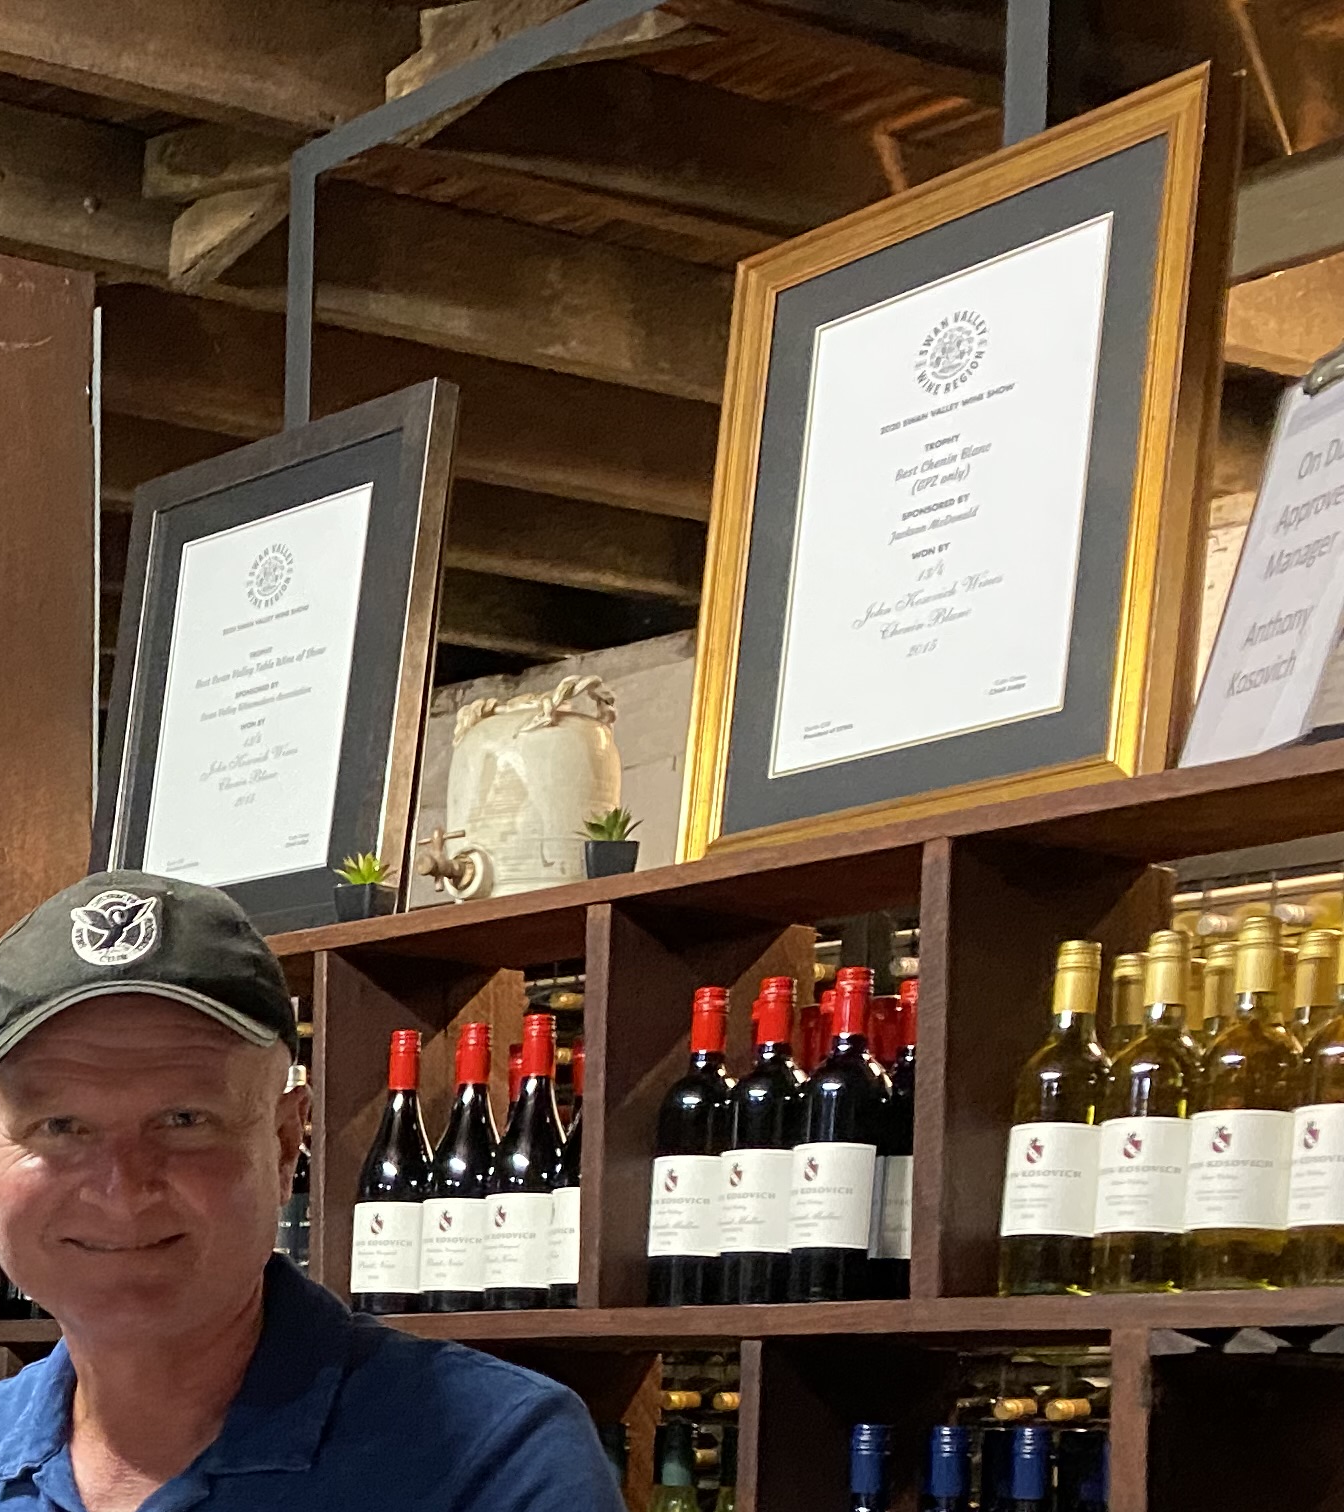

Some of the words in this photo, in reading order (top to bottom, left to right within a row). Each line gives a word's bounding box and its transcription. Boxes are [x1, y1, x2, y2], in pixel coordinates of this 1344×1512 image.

[918, 317, 949, 356] SWAN
[953, 310, 987, 336] VALLEY
[917, 369, 941, 395] WINE
[943, 350, 985, 394] REGION
[895, 467, 919, 482] Best
[920, 453, 958, 474] Chenin
[960, 442, 992, 460] Blanc
[924, 433, 961, 451] TROPHY
[940, 462, 971, 484] only)
[1298, 451, 1322, 480] On
[902, 498, 955, 521] SPONSORED
[957, 493, 971, 505] BY
[912, 546, 936, 560] WON
[938, 542, 951, 553] BY
[1264, 531, 1341, 581] Manager
[1242, 604, 1315, 650] Anthony
[1226, 649, 1297, 699] Kosovich
